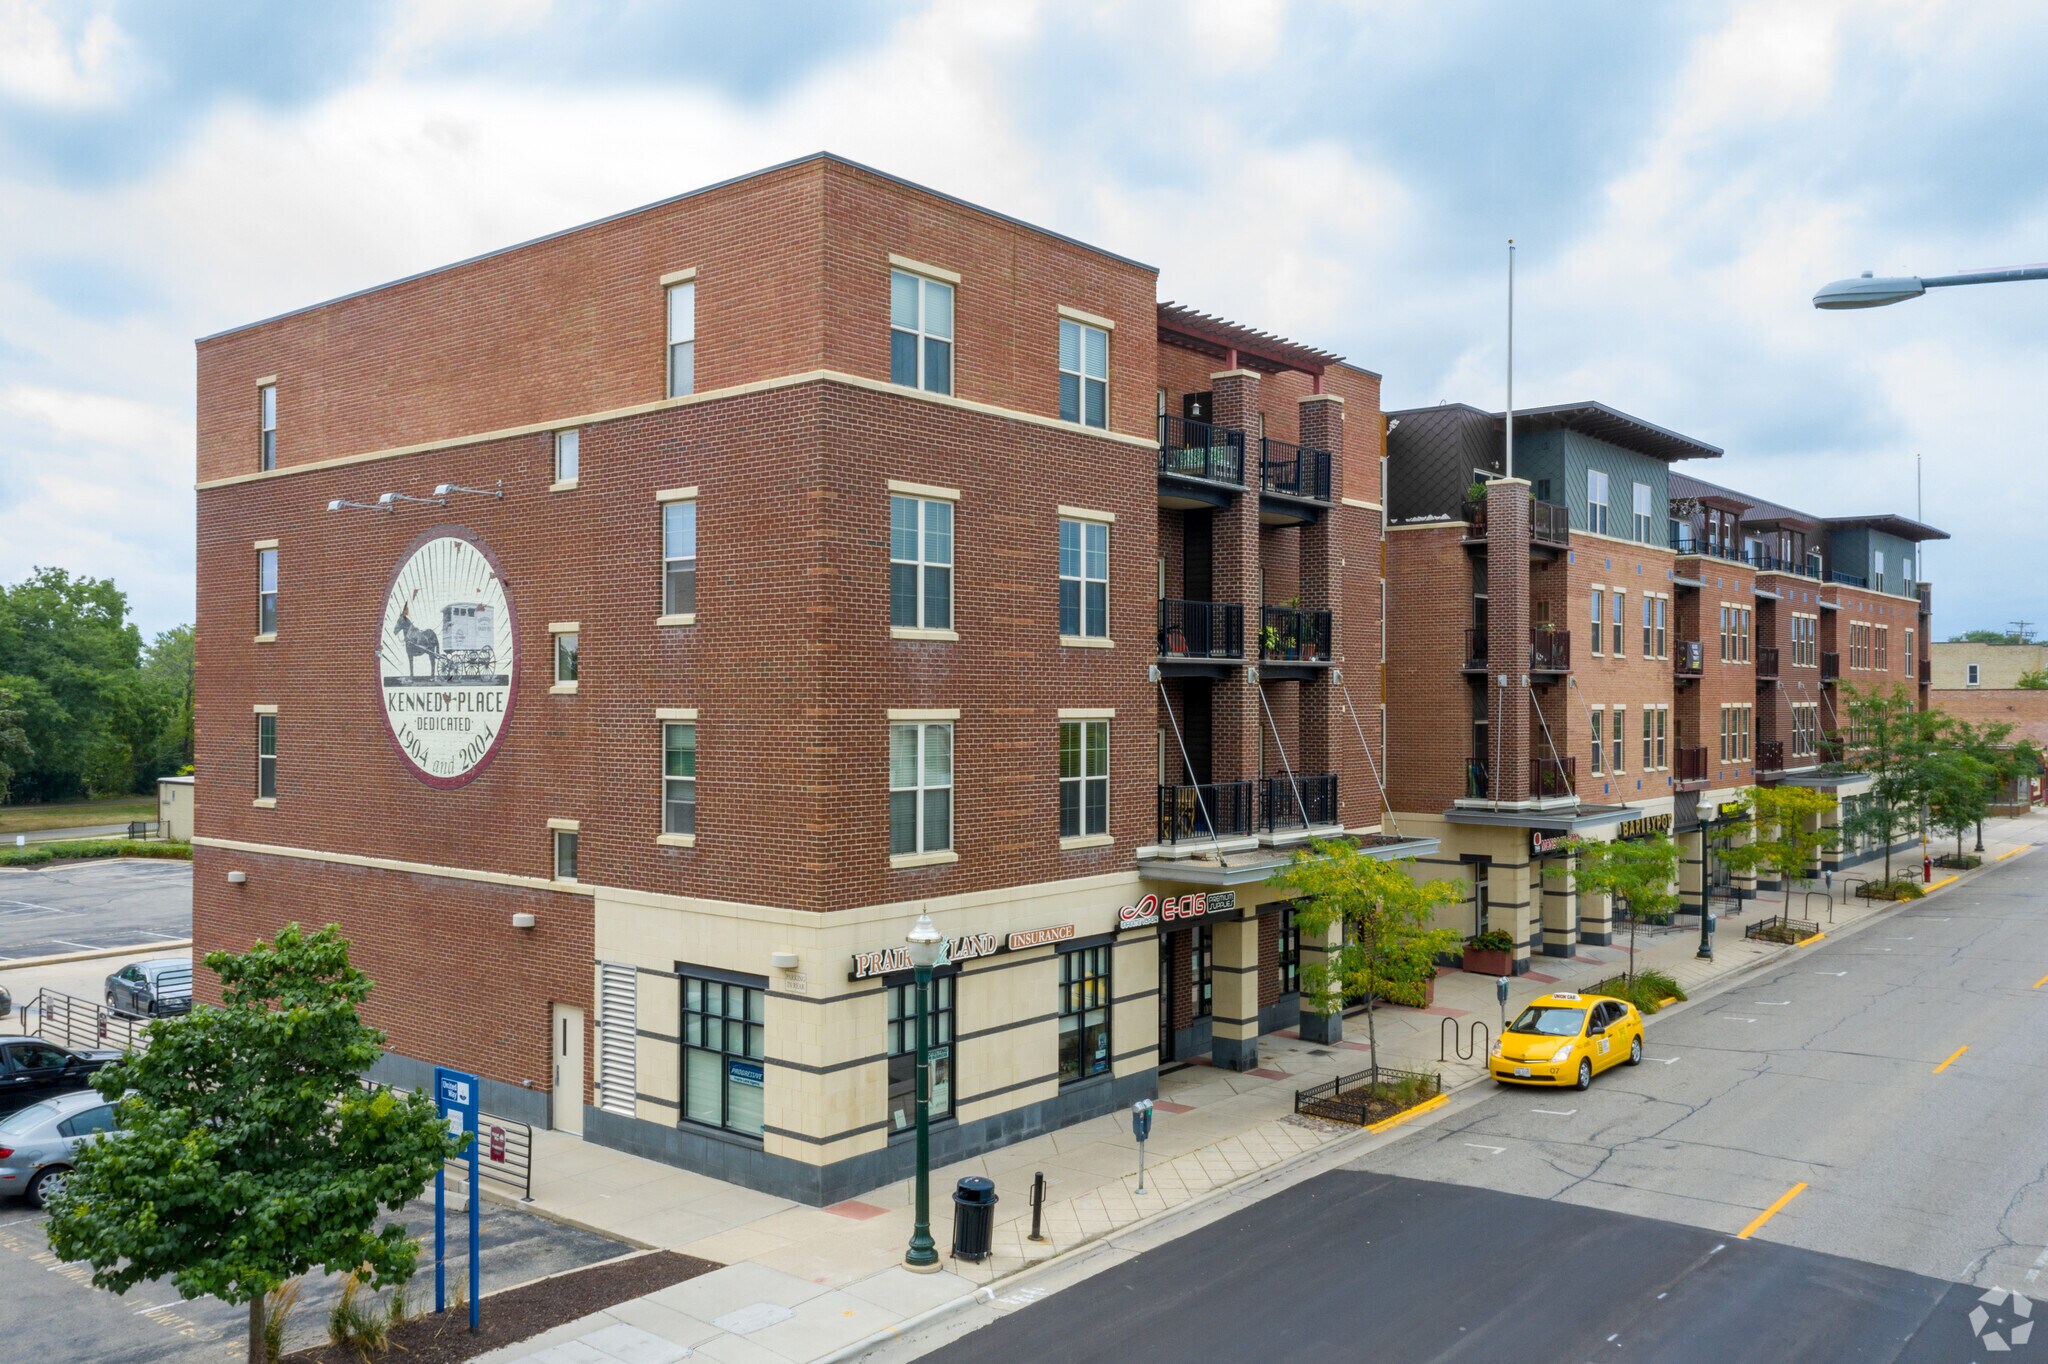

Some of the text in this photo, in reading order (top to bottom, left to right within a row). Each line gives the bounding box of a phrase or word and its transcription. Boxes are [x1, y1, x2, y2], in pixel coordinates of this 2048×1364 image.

[388, 691, 504, 712] KENNEDY PLACE
[417, 716, 471, 731] DEDICATED
[397, 720, 494, 775] 1904 and 2004
[1622, 813, 1672, 837] BARLEYPOP
[1208, 893, 1234, 904] PREMIUM
[1209, 900, 1234, 911] SUPPLIES
[1162, 892, 1206, 921] E-CIG
[1013, 925, 1073, 948] INSURANCE
[949, 933, 998, 960] LAND
[731, 1067, 763, 1080] PROGRESSIVE
[1550, 1067, 1560, 1075] 07
[442, 1081, 457, 1091] United
[448, 1090, 457, 1100] Way
